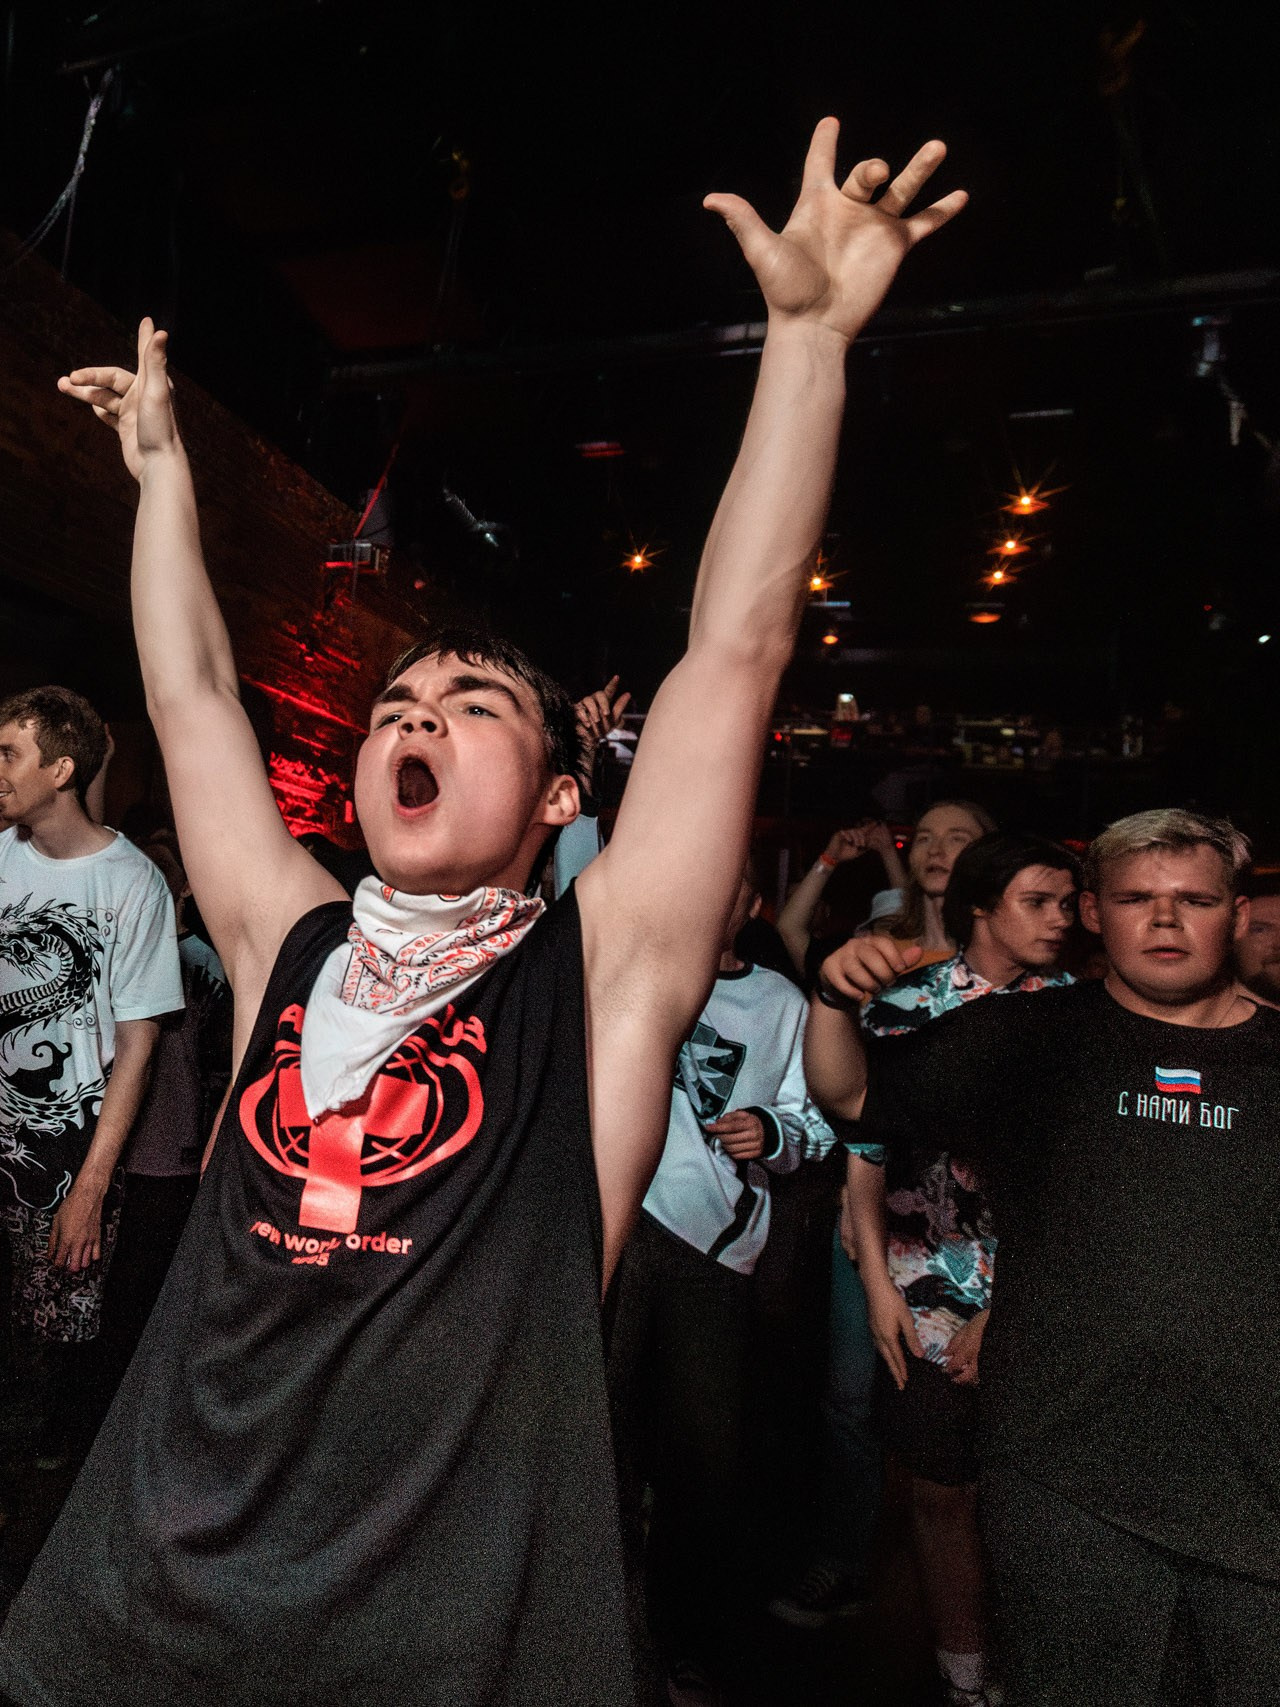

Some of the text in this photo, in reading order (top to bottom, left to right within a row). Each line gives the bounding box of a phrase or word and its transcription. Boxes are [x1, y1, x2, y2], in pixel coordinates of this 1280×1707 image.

[1118, 1091, 1240, 1130] С НАМИ БОГ
[345, 1230, 413, 1254] order
